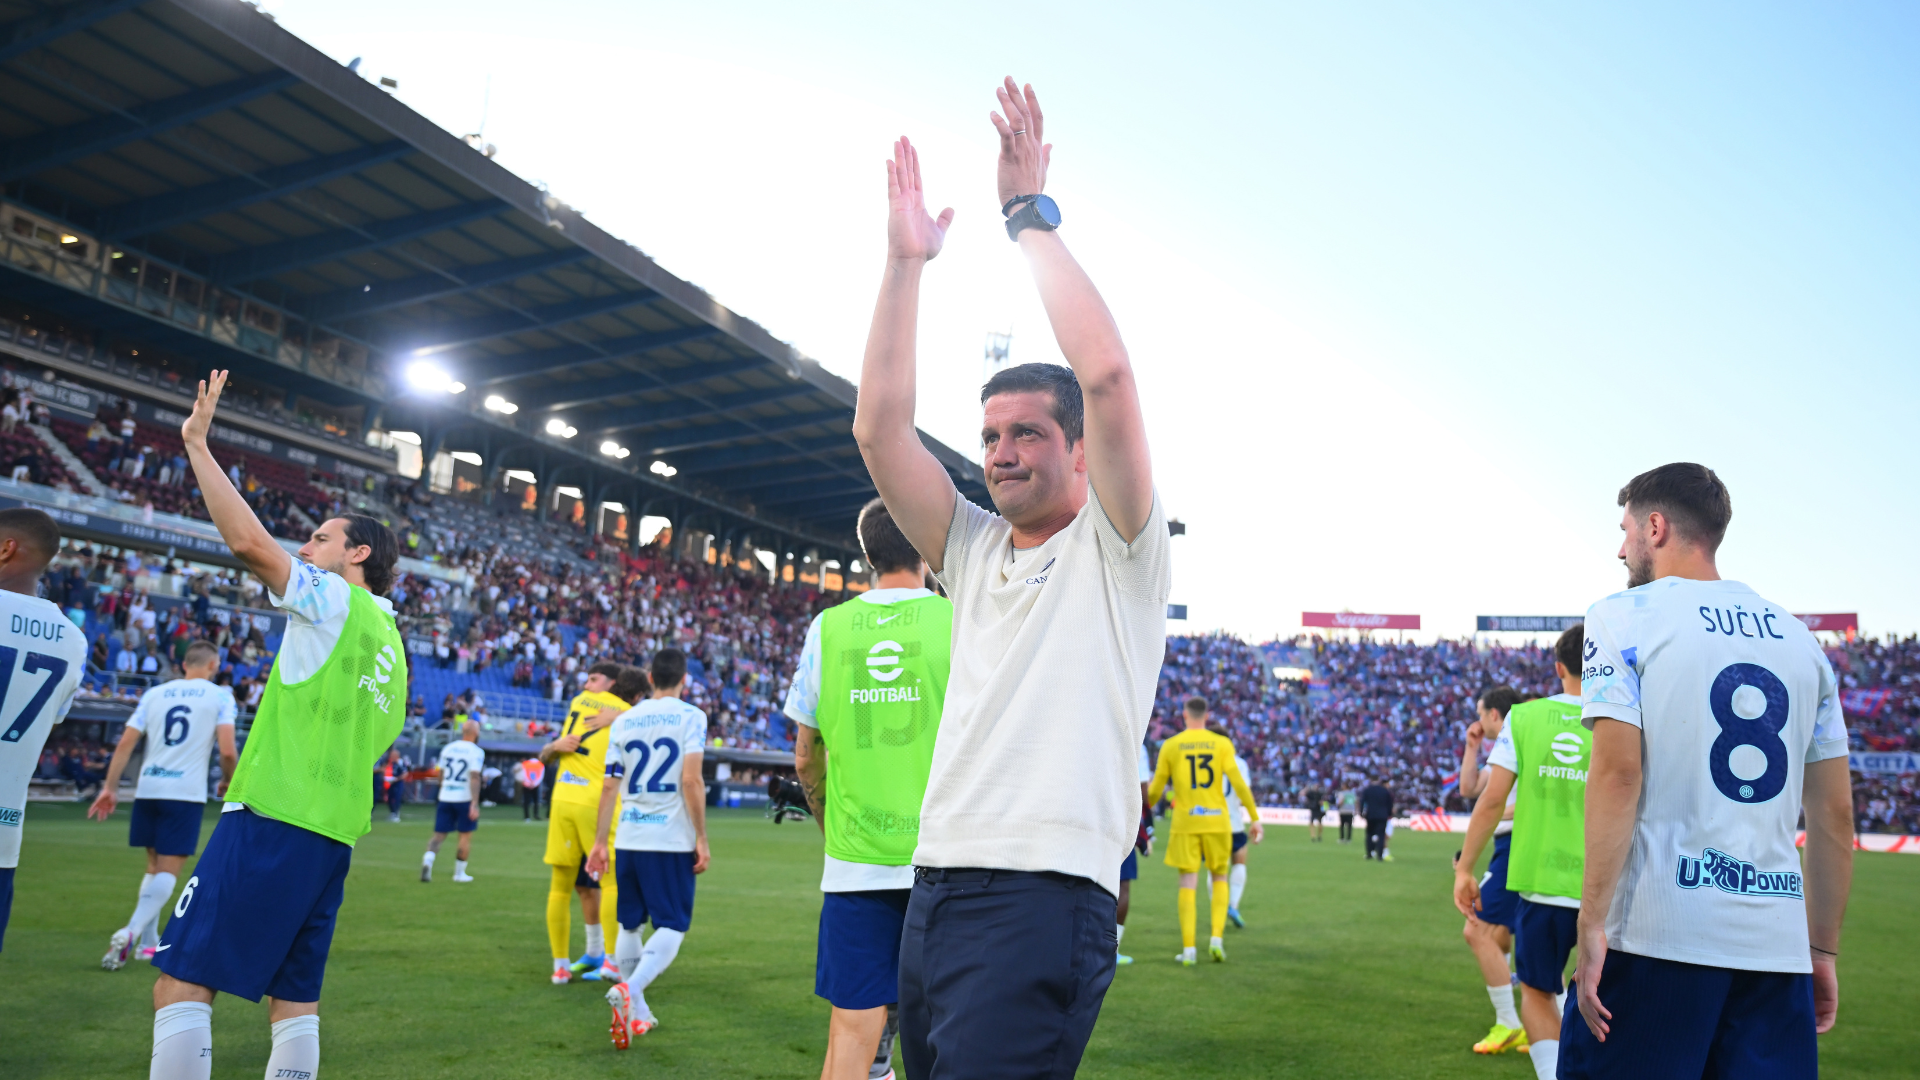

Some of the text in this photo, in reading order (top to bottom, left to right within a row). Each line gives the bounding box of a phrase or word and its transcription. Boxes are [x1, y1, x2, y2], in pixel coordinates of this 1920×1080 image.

[11, 614, 66, 642] DIOUF
[850, 686, 921, 704] FOOTBALL
[164, 704, 192, 746] 6
[1709, 662, 1790, 804] 8
[445, 757, 468, 782] 32
[624, 737, 680, 794] 22
[1185, 754, 1214, 789] 13
[174, 876, 199, 918] 6
[275, 1069, 311, 1080] INTER
